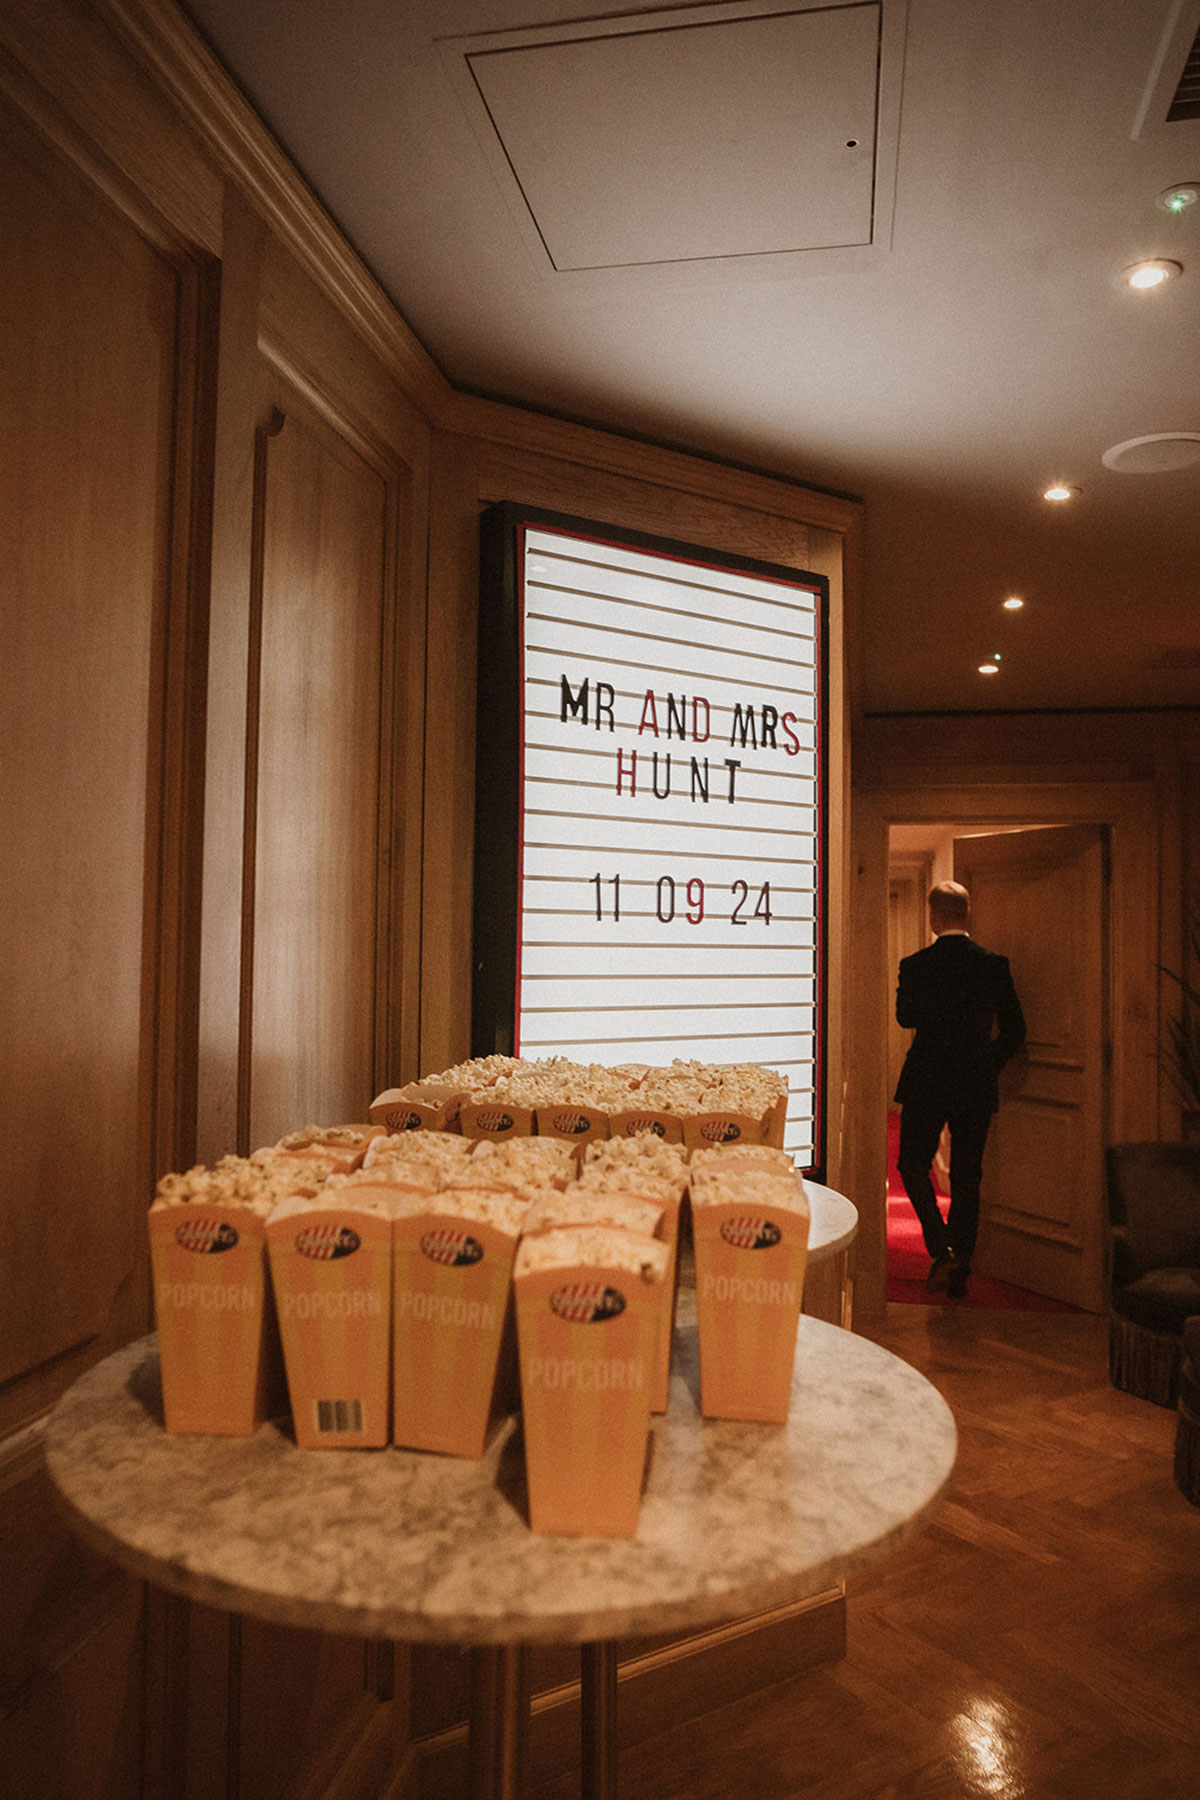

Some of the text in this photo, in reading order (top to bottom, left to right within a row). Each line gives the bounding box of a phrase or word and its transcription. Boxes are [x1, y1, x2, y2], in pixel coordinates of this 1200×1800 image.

[560, 674, 801, 756] MR AND MRS
[616, 747, 741, 804] HUNT
[589, 873, 773, 926] 11 09 24
[160, 1283, 255, 1310] POPCORN
[283, 1291, 381, 1319] POPCORN
[703, 1274, 796, 1305] POPCORN
[401, 1291, 496, 1329] POPCORN
[528, 1358, 643, 1390] POPCORN
